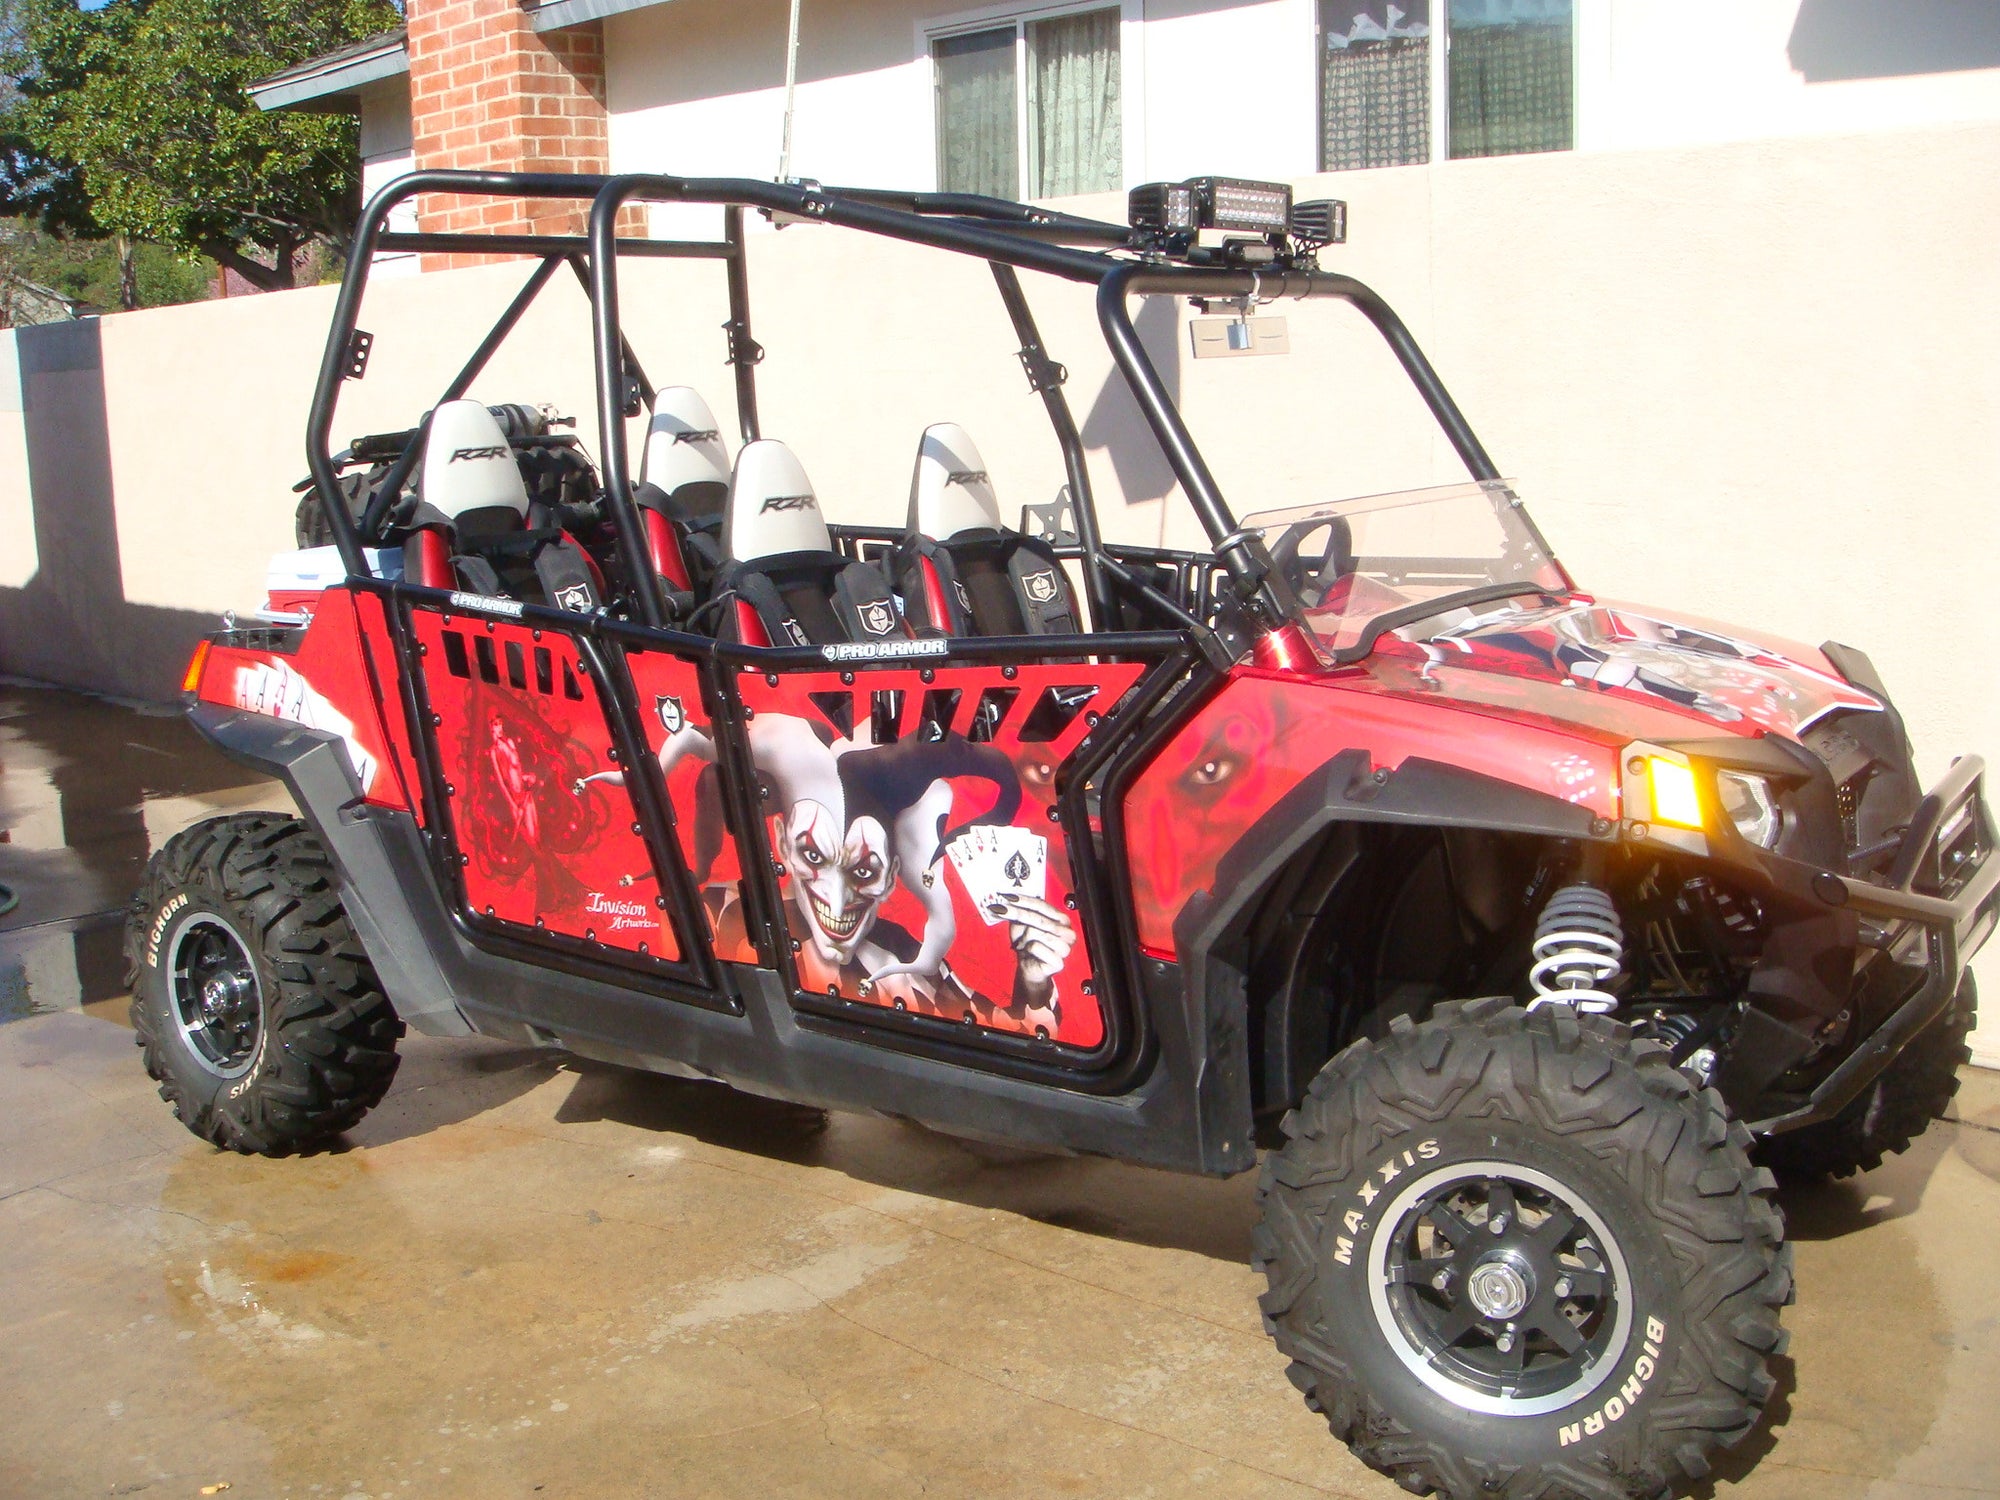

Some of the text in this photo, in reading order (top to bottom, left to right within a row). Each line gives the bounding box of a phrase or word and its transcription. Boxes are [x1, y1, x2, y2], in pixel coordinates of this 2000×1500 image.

[672, 430, 718, 446] RZR
[449, 446, 508, 464] RZR
[944, 471, 988, 488] RZR
[759, 494, 816, 515] RZR
[460, 593, 522, 615] PRO ARMOR
[840, 640, 945, 658] PRO ARMOR
[585, 892, 646, 917] Invision
[147, 893, 189, 968] BIGHORN
[1334, 1138, 1441, 1265] MAXXIS
[1558, 1315, 1667, 1447] BIGHORN
